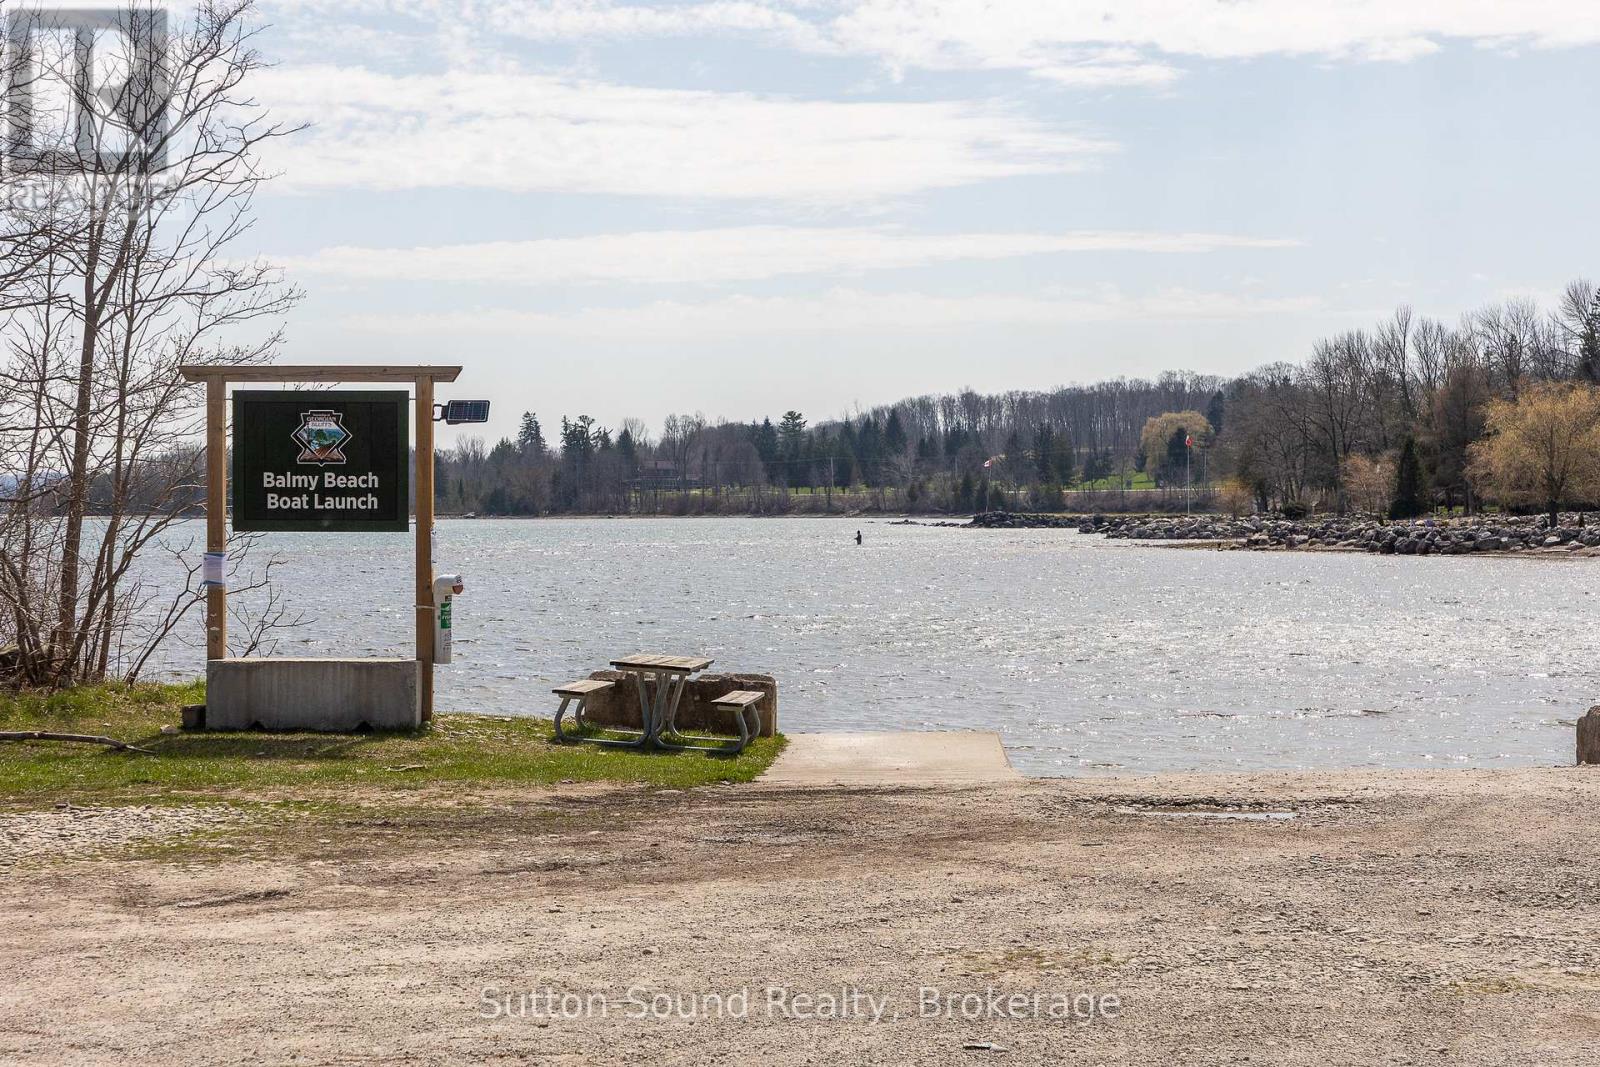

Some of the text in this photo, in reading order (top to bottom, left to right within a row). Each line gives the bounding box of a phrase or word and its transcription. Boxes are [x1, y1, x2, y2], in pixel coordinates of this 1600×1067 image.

[263, 471, 379, 490] Balmy Beach
[267, 493, 378, 509] Boat Launch
